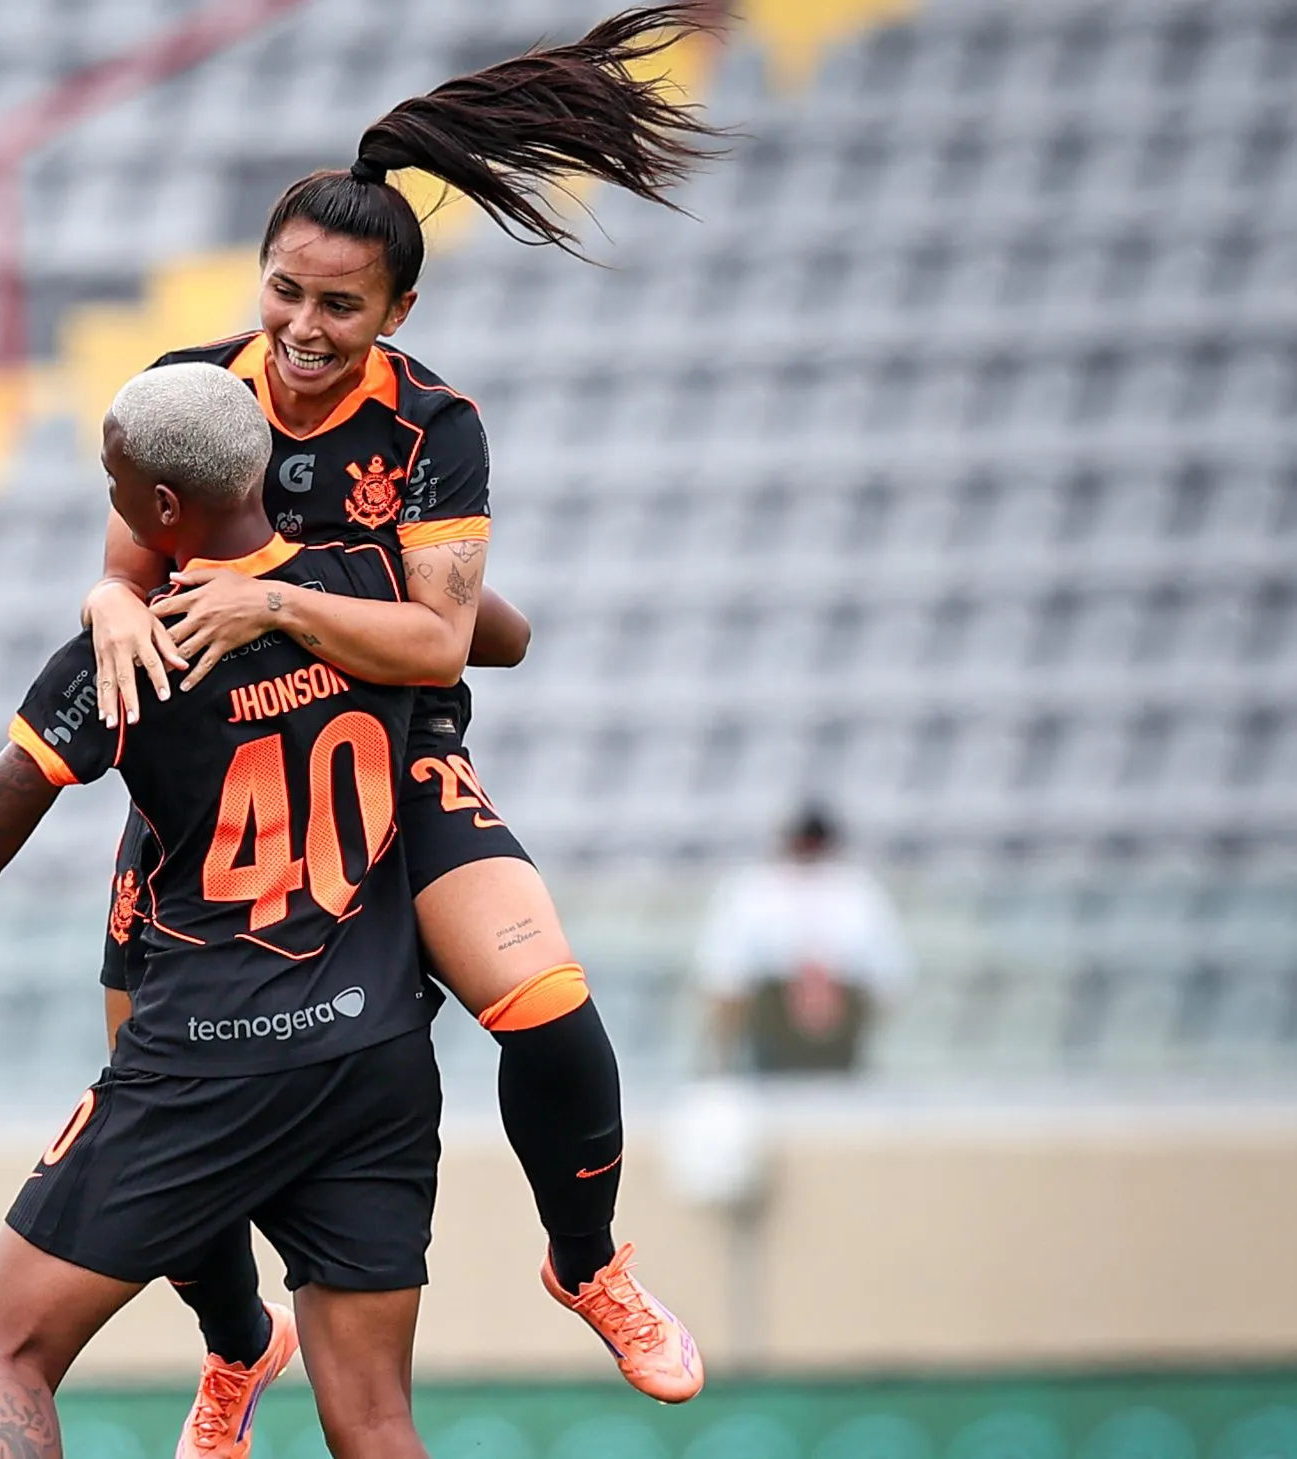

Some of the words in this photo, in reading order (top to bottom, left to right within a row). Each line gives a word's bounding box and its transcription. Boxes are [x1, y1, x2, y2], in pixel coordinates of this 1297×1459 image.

[279, 454, 316, 493] G
[55, 675, 97, 731] bm
[63, 670, 89, 699] banco
[410, 754, 502, 821] 20
[203, 710, 393, 932] 40
[188, 1002, 335, 1041] tecnogera
